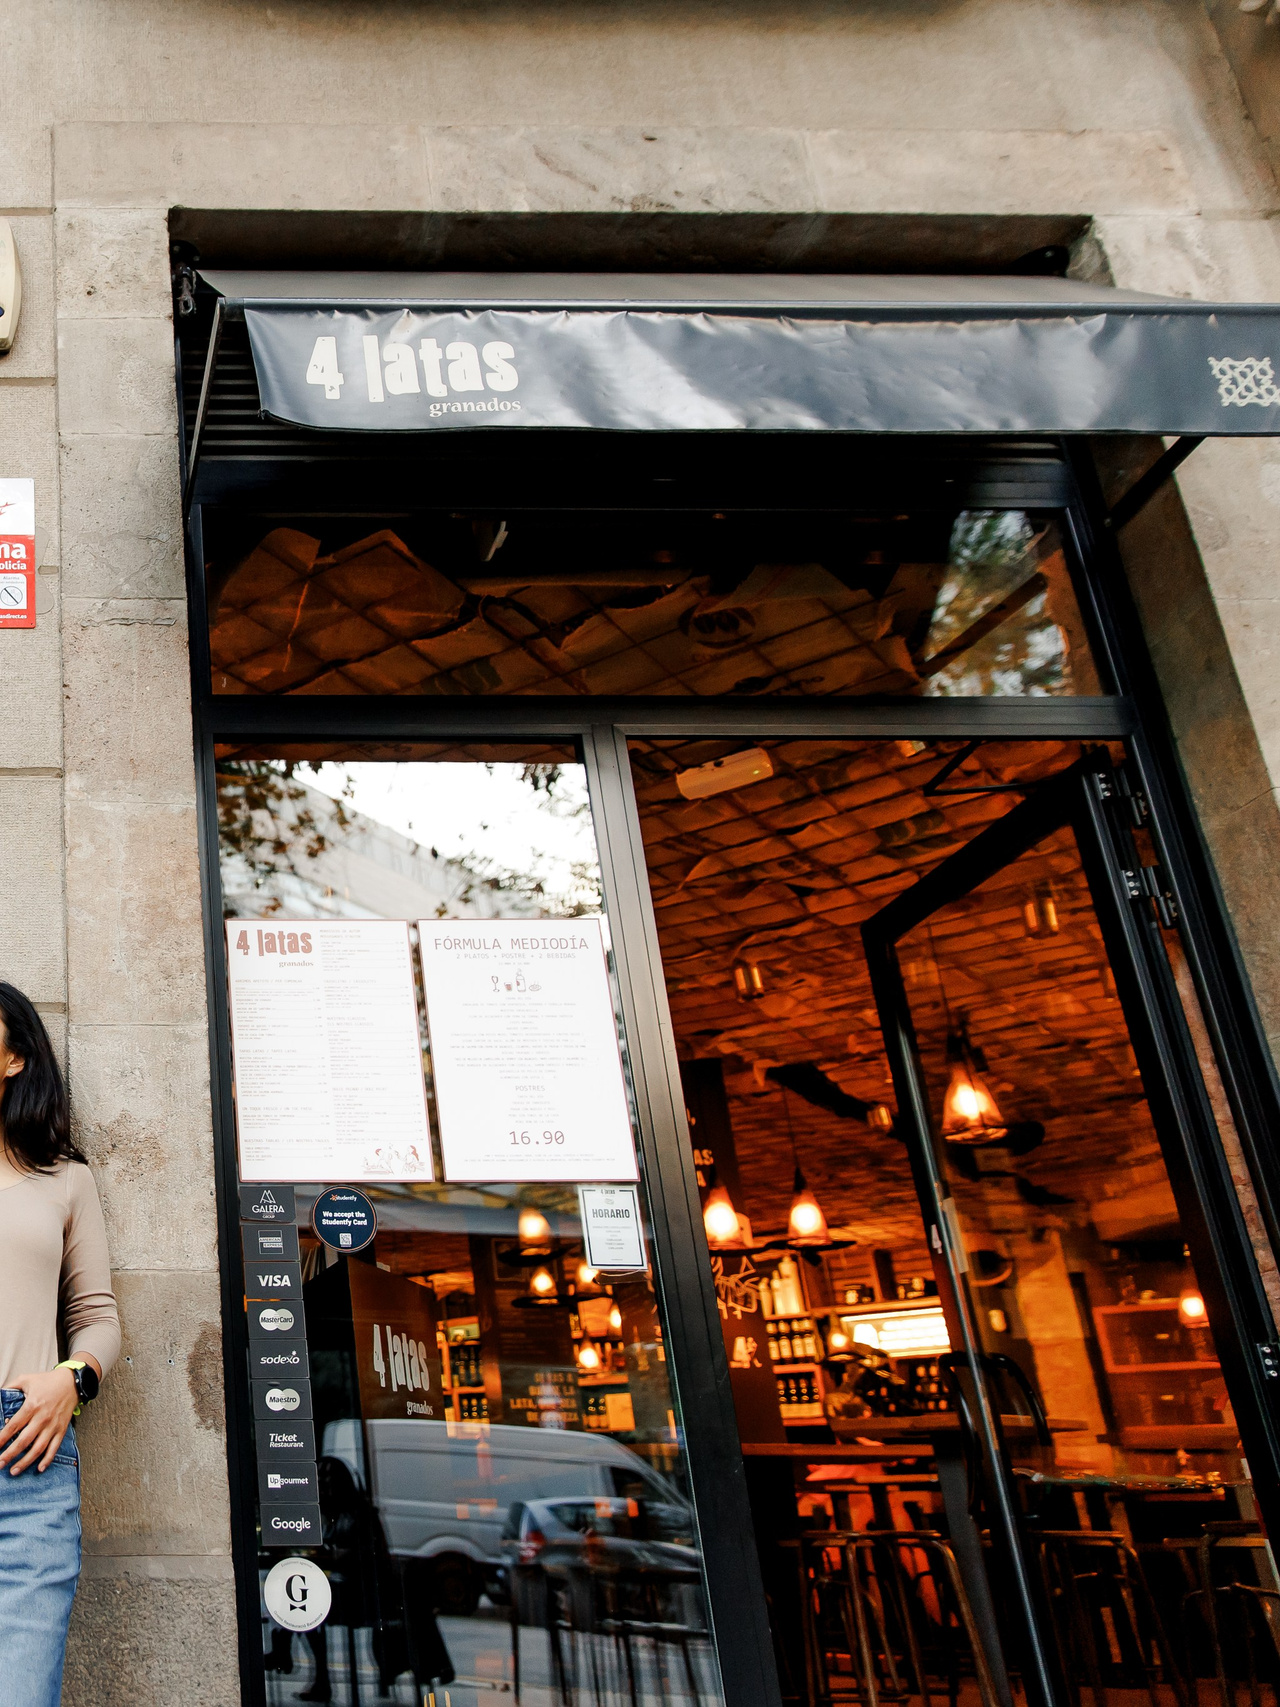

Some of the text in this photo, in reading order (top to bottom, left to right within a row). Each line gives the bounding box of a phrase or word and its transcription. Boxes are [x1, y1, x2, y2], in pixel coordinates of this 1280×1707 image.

[306, 335, 519, 403] 4 latas
[429, 397, 521, 418] granados
[236, 929, 250, 956] 4
[257, 929, 313, 957] latas
[434, 934, 589, 950] FÓRMULA MEDIODÍA
[464, 952, 490, 960] PLATOS
[501, 952, 526, 960] POSTRE
[546, 952, 576, 960] BEBIDAS
[278, 960, 314, 968] granados
[509, 1130, 565, 1146] 16.90
[251, 1204, 285, 1213] GALERA
[333, 1211, 355, 1219] accept
[592, 1208, 631, 1219] HORARIO
[256, 1275, 291, 1287] VISA
[260, 1354, 300, 1365] sodexo
[373, 1323, 430, 1392] 4 latas
[406, 1400, 434, 1416] granados
[269, 1433, 298, 1442] Ticket
[271, 1517, 311, 1532] Google
[285, 1574, 309, 1603] G
